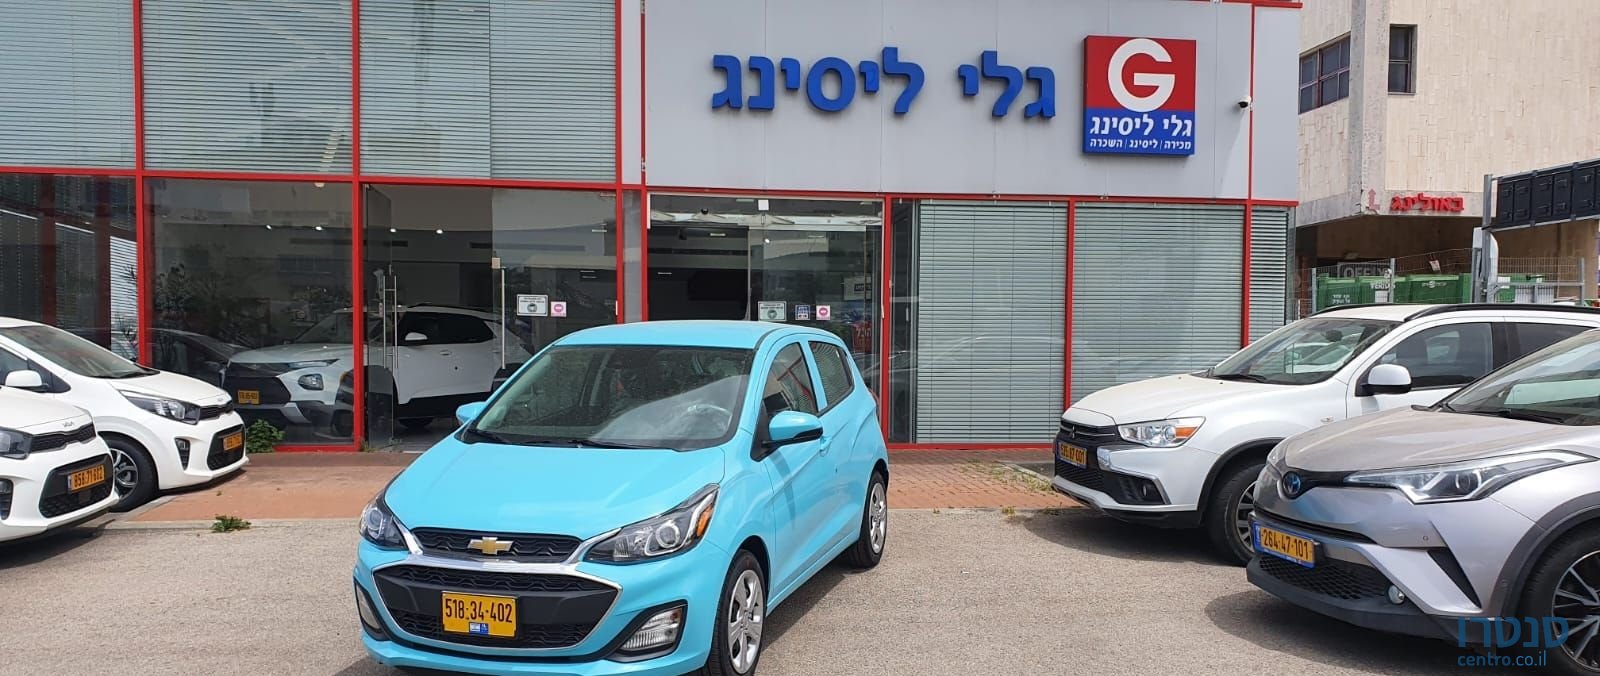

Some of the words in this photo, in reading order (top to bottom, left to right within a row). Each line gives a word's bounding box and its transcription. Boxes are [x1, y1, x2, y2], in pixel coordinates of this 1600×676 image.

[712, 46, 925, 114] ליסינג
[956, 50, 1056, 118] גלי
[1107, 37, 1175, 112] G
[1089, 112, 1155, 136] ליסינג
[1162, 114, 1193, 137] גלי
[1089, 137, 1123, 148] השכרה
[1128, 138, 1159, 149] ליסינג
[1163, 139, 1192, 150] מכירה
[1391, 192, 1464, 212] באולינג
[445, 598, 513, 624] 518-34-402
